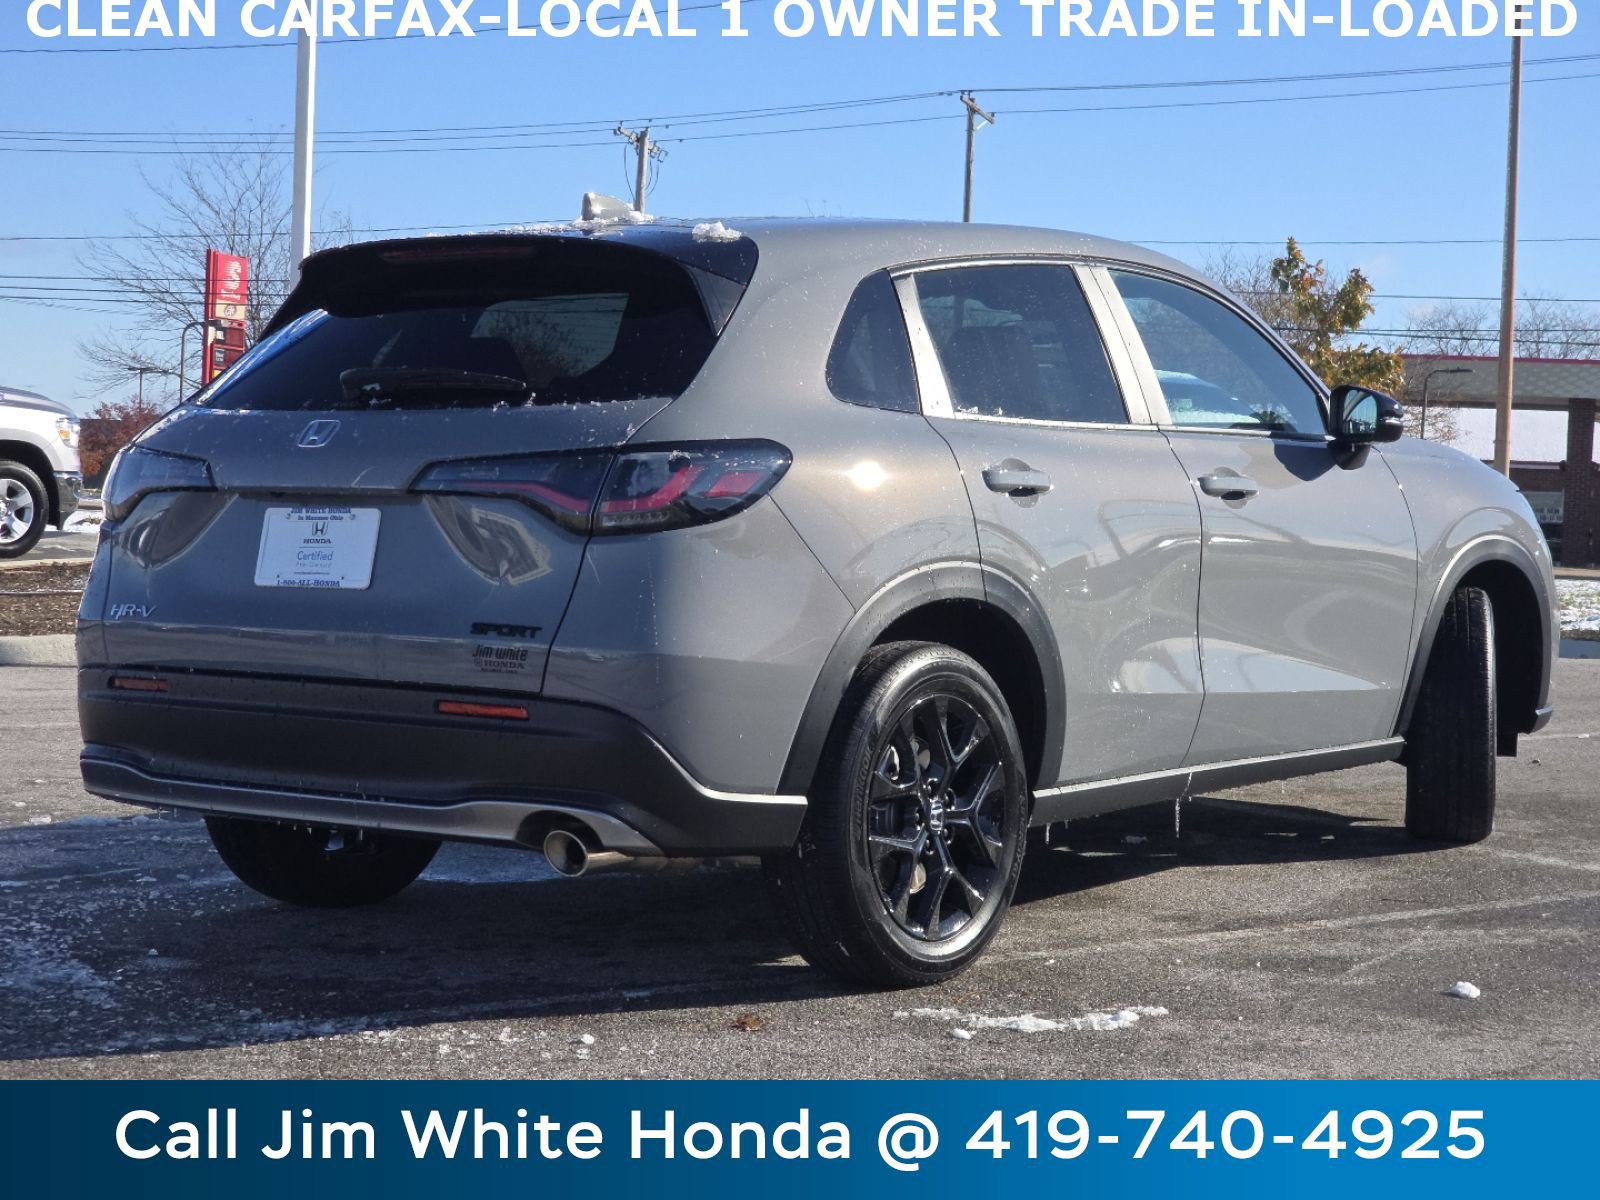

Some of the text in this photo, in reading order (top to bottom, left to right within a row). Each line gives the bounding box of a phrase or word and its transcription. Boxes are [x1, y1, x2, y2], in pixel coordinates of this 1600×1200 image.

[297, 550, 334, 561] Certified
[110, 603, 157, 620] HR-V
[470, 622, 542, 638] SPORT
